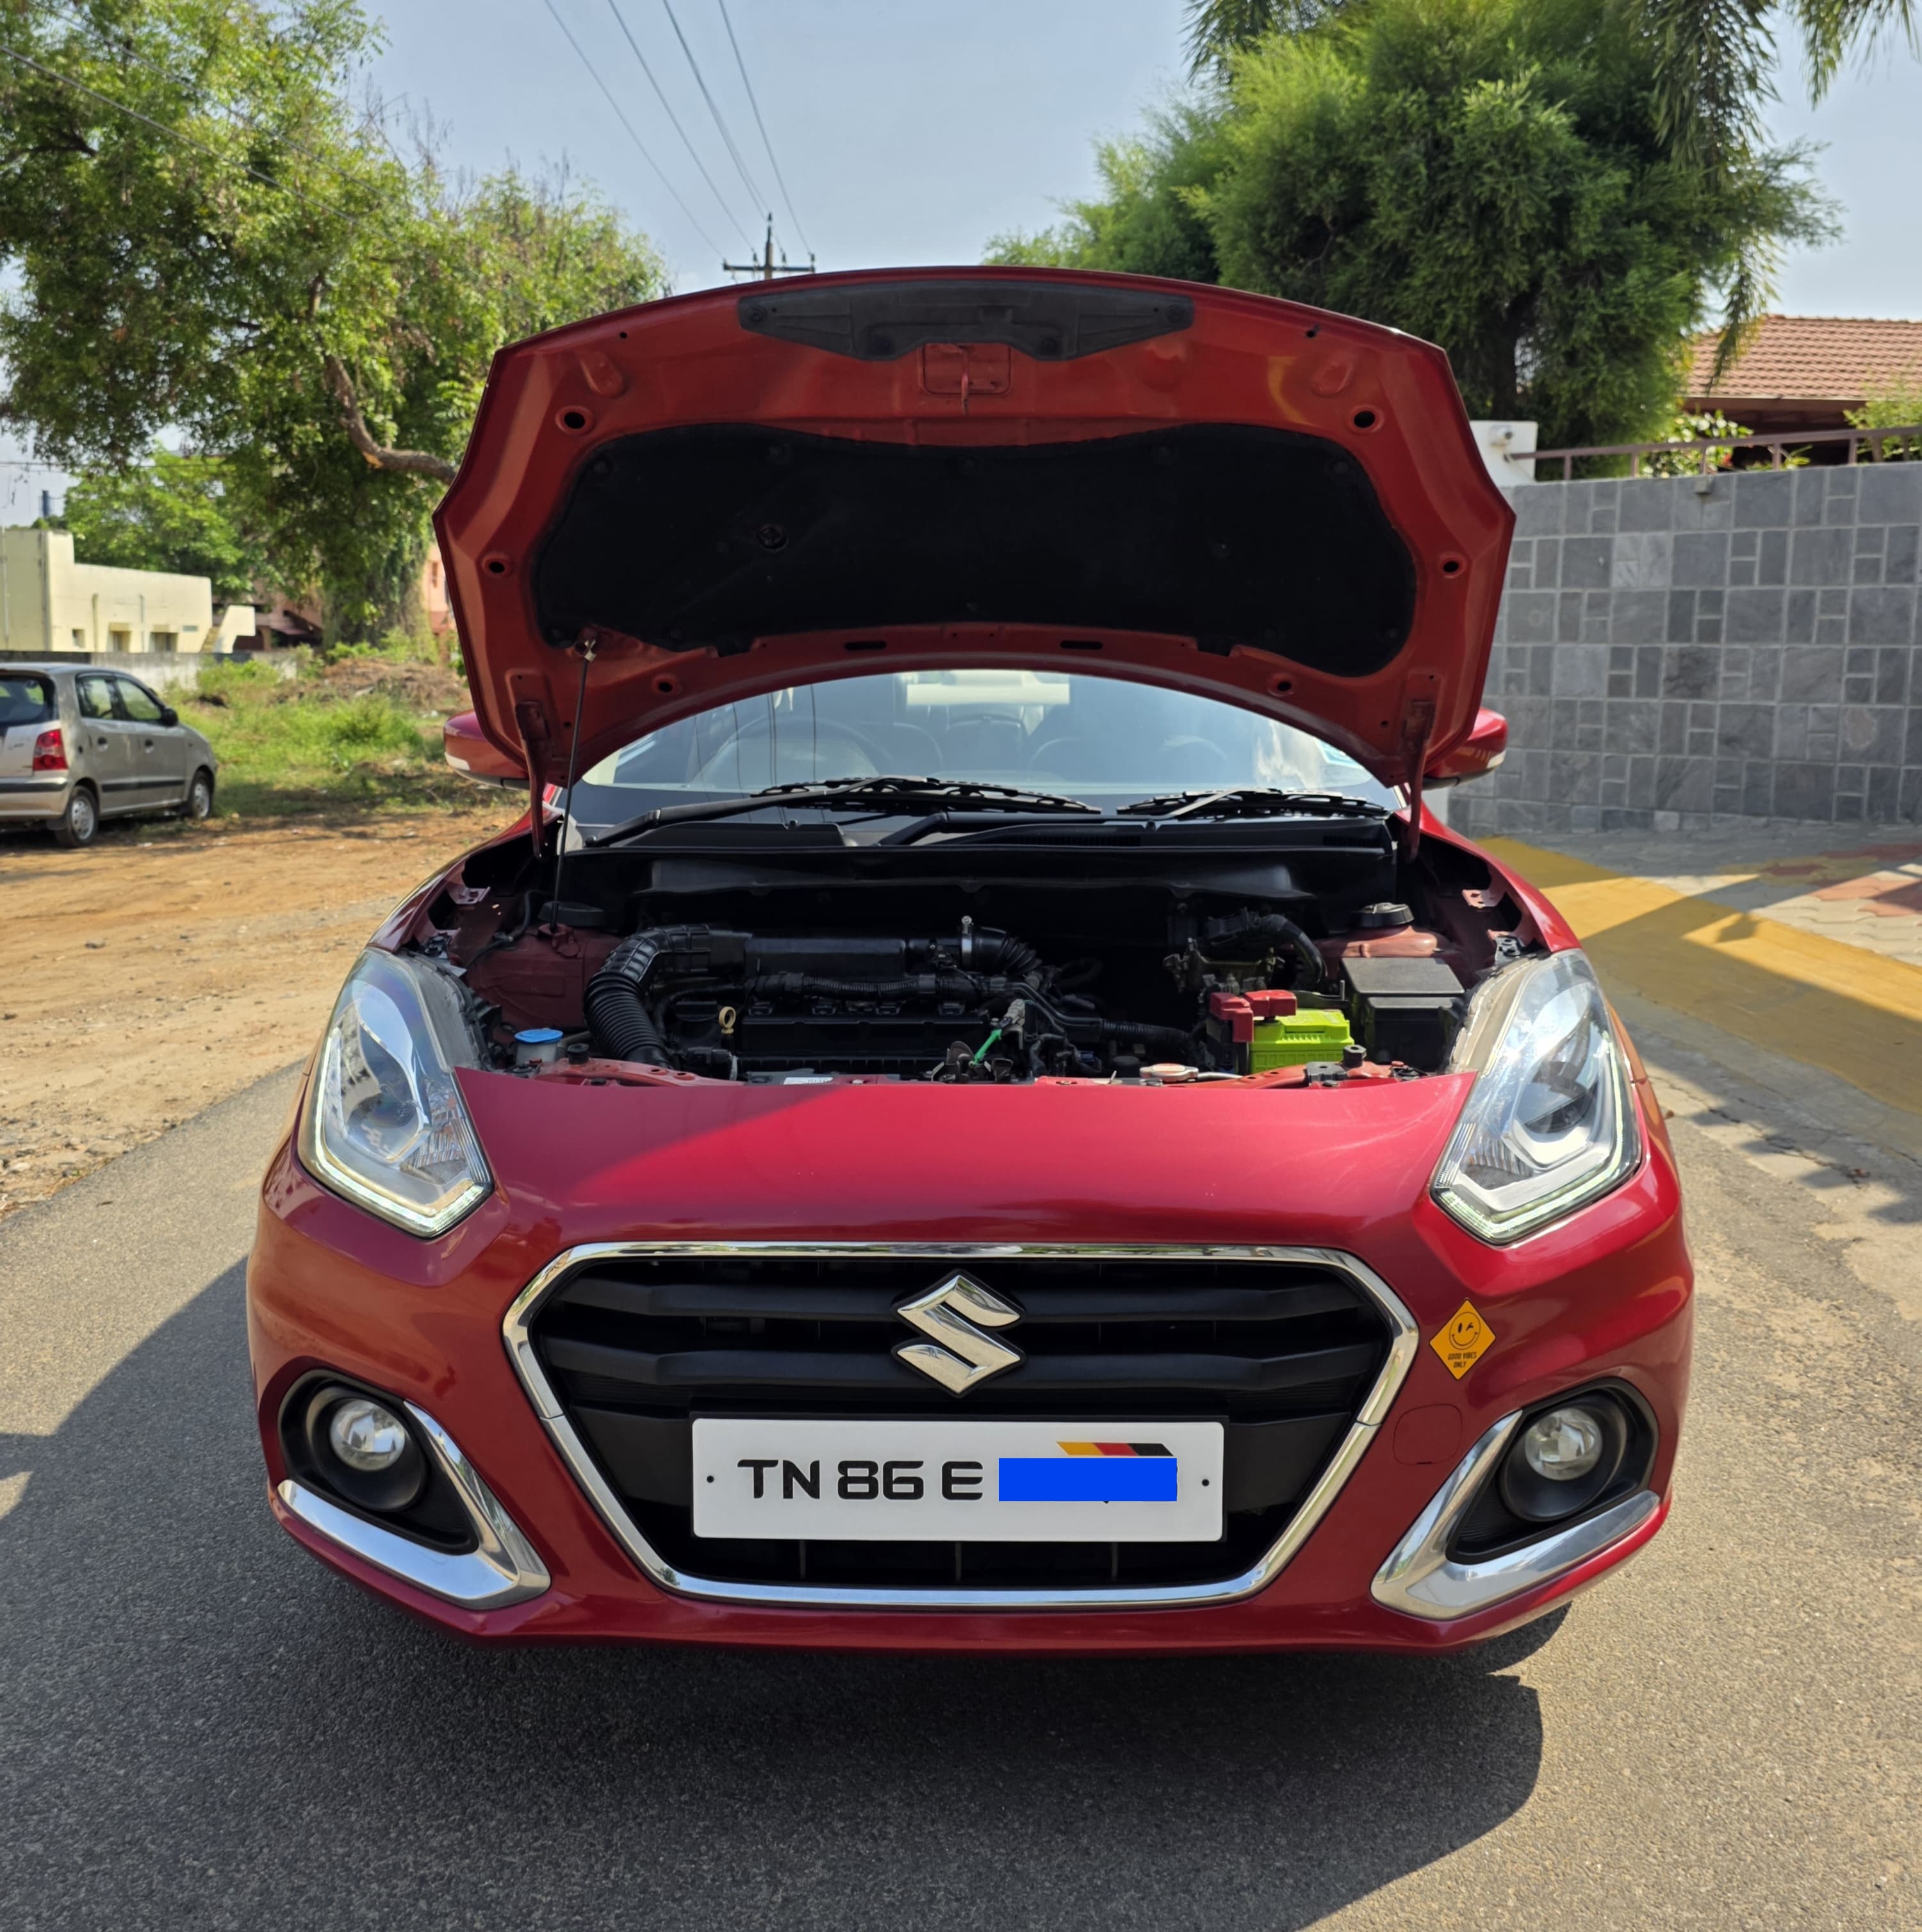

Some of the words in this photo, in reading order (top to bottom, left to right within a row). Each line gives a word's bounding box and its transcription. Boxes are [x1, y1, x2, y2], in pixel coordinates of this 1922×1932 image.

[737, 1459, 821, 1500] TN
[837, 1459, 924, 1500] 86
[941, 1460, 983, 1500] E
